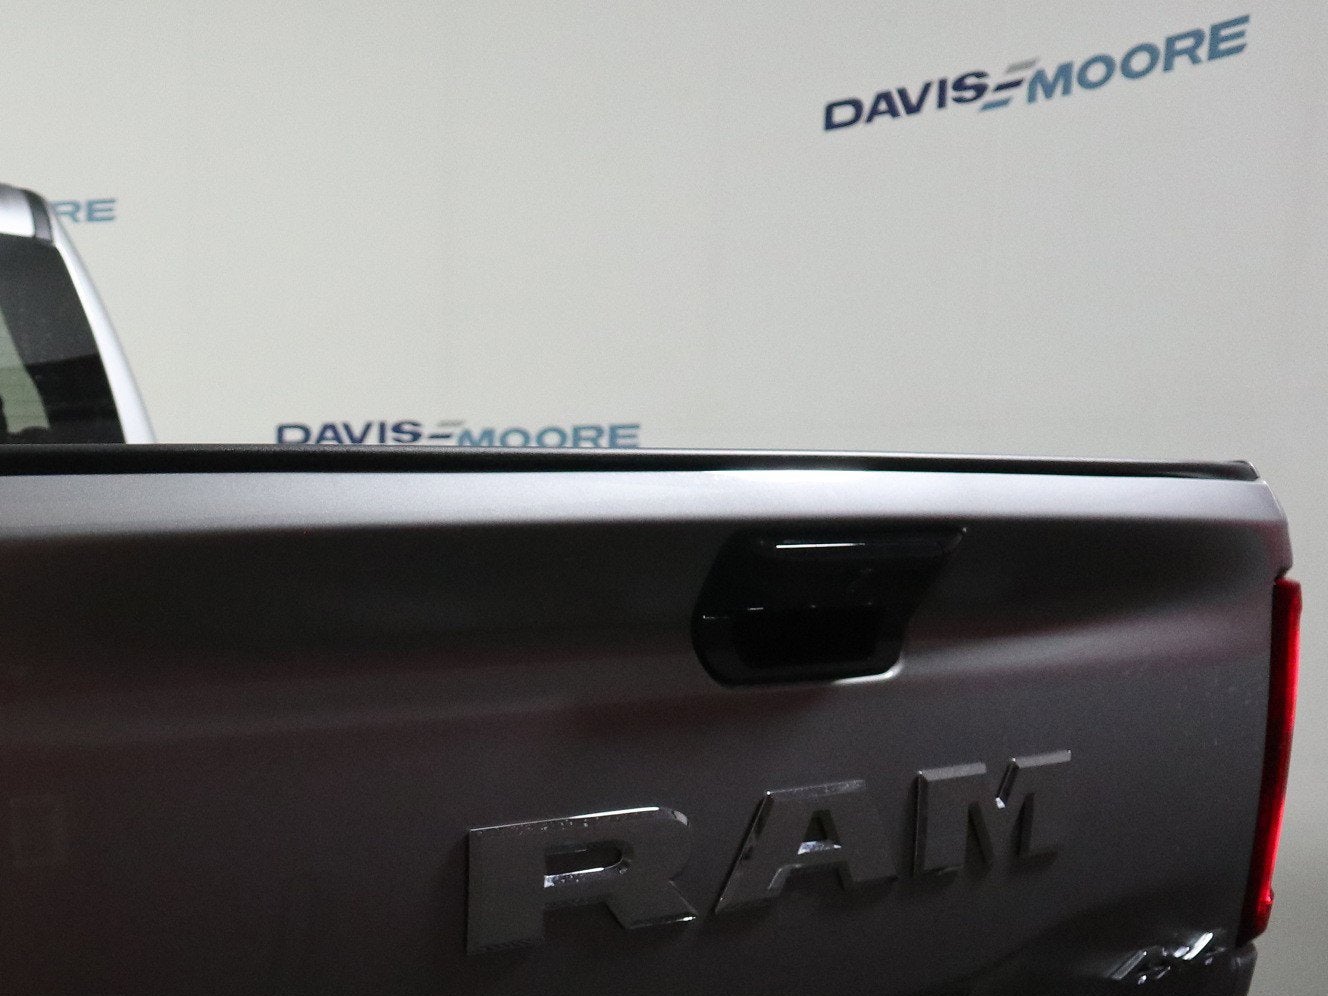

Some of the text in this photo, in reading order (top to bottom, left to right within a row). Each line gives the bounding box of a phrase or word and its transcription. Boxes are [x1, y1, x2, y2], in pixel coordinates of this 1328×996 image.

[823, 14, 1250, 131] DAVIS MOORE
[276, 420, 640, 448] DAVIS MOORE
[466, 750, 1073, 953] RAM
